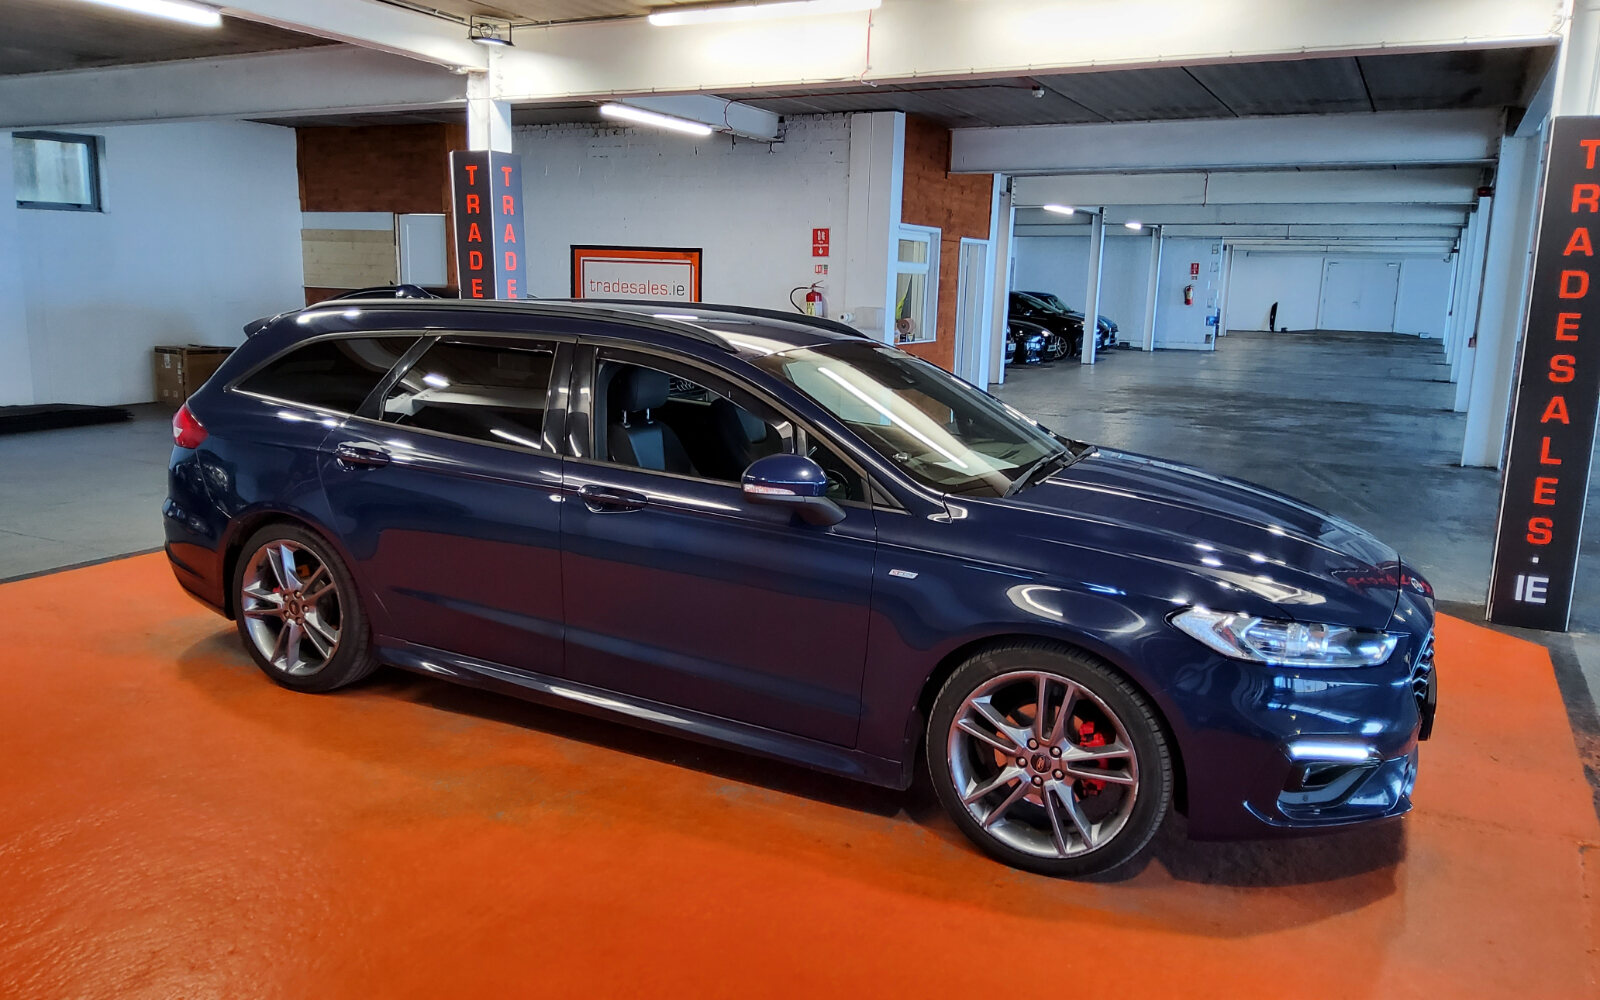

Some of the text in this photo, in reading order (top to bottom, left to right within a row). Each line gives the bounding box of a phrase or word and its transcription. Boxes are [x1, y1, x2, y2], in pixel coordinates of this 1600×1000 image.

[465, 165, 484, 298] TRADE
[501, 166, 518, 299] TRADE
[590, 278, 685, 296] tradesales.ie
